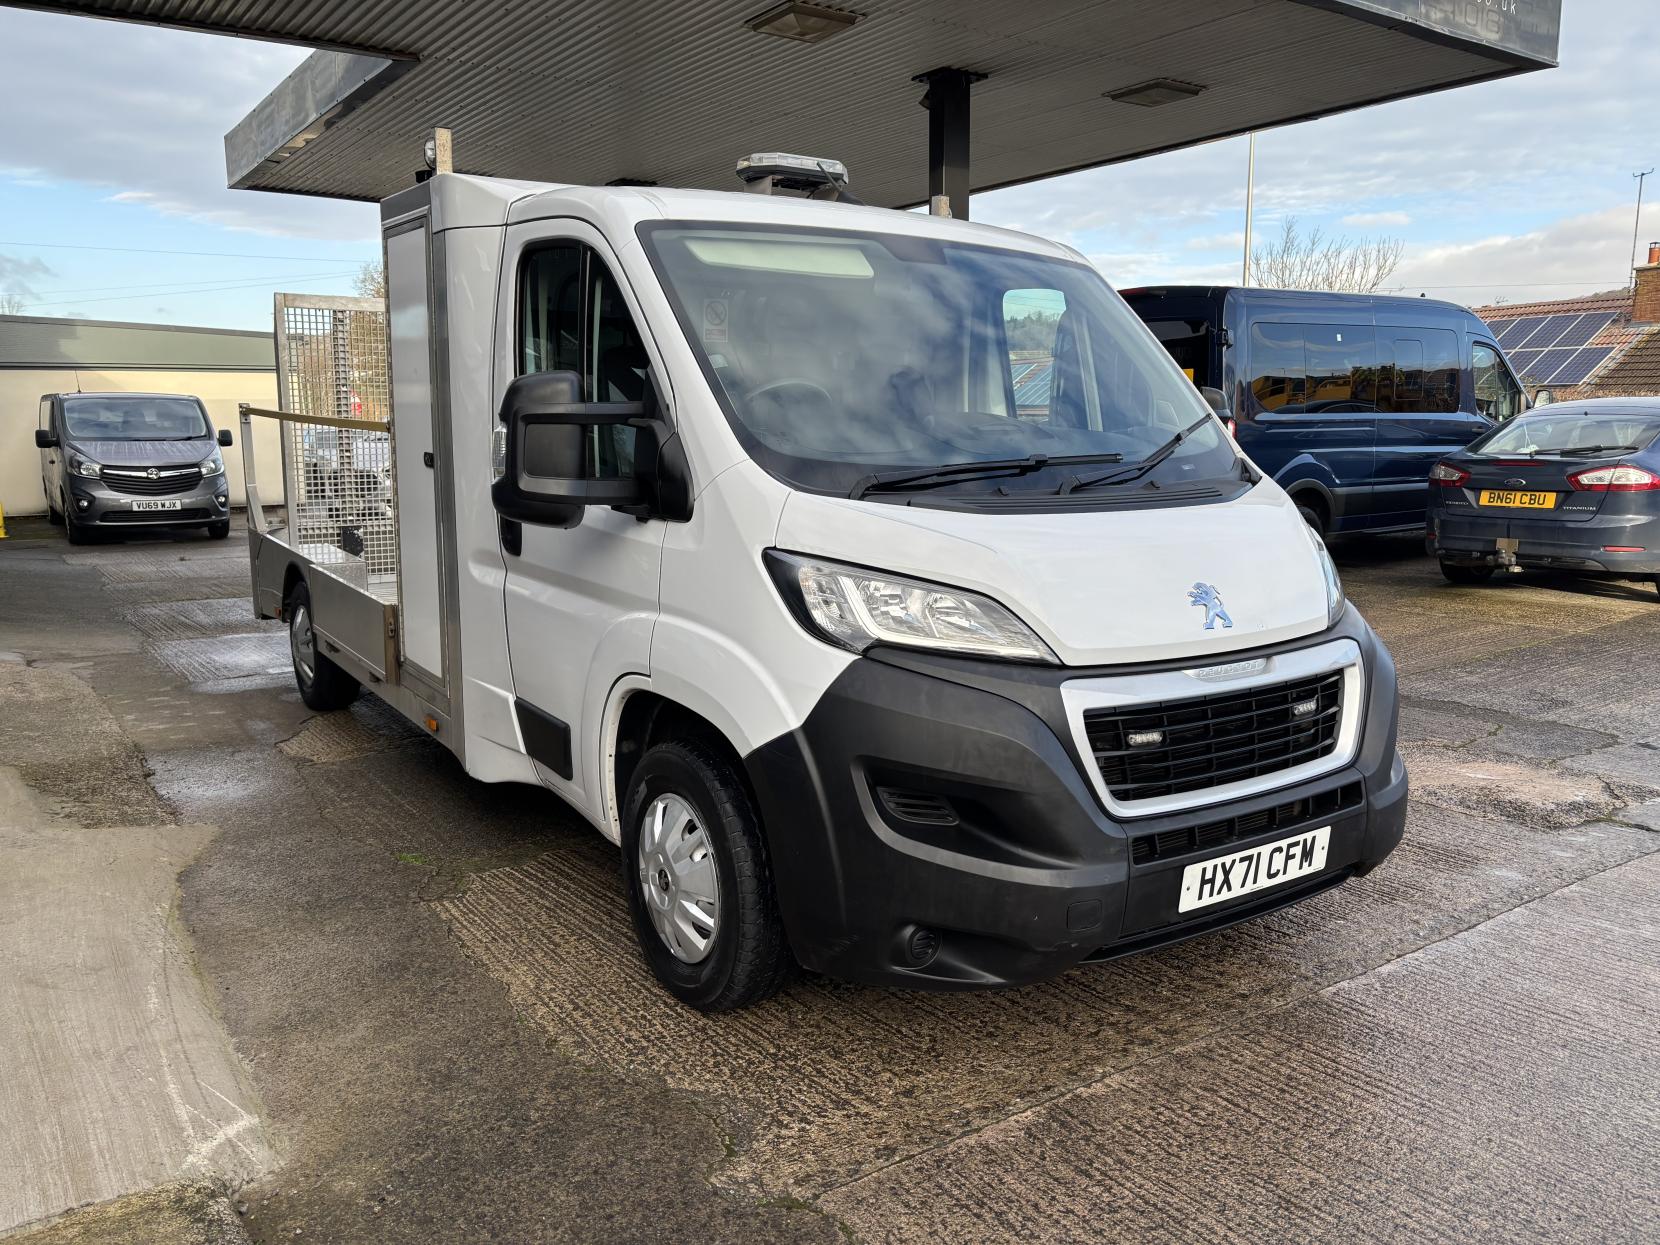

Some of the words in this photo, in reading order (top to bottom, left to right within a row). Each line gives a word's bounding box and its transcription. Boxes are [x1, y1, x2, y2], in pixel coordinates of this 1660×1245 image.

[136, 501, 159, 510] VU69
[160, 501, 177, 509] WJX
[1487, 491, 1517, 505] BN61
[1519, 493, 1547, 506] CBU
[1197, 852, 1262, 901] HX71
[1266, 835, 1317, 880] CFM
